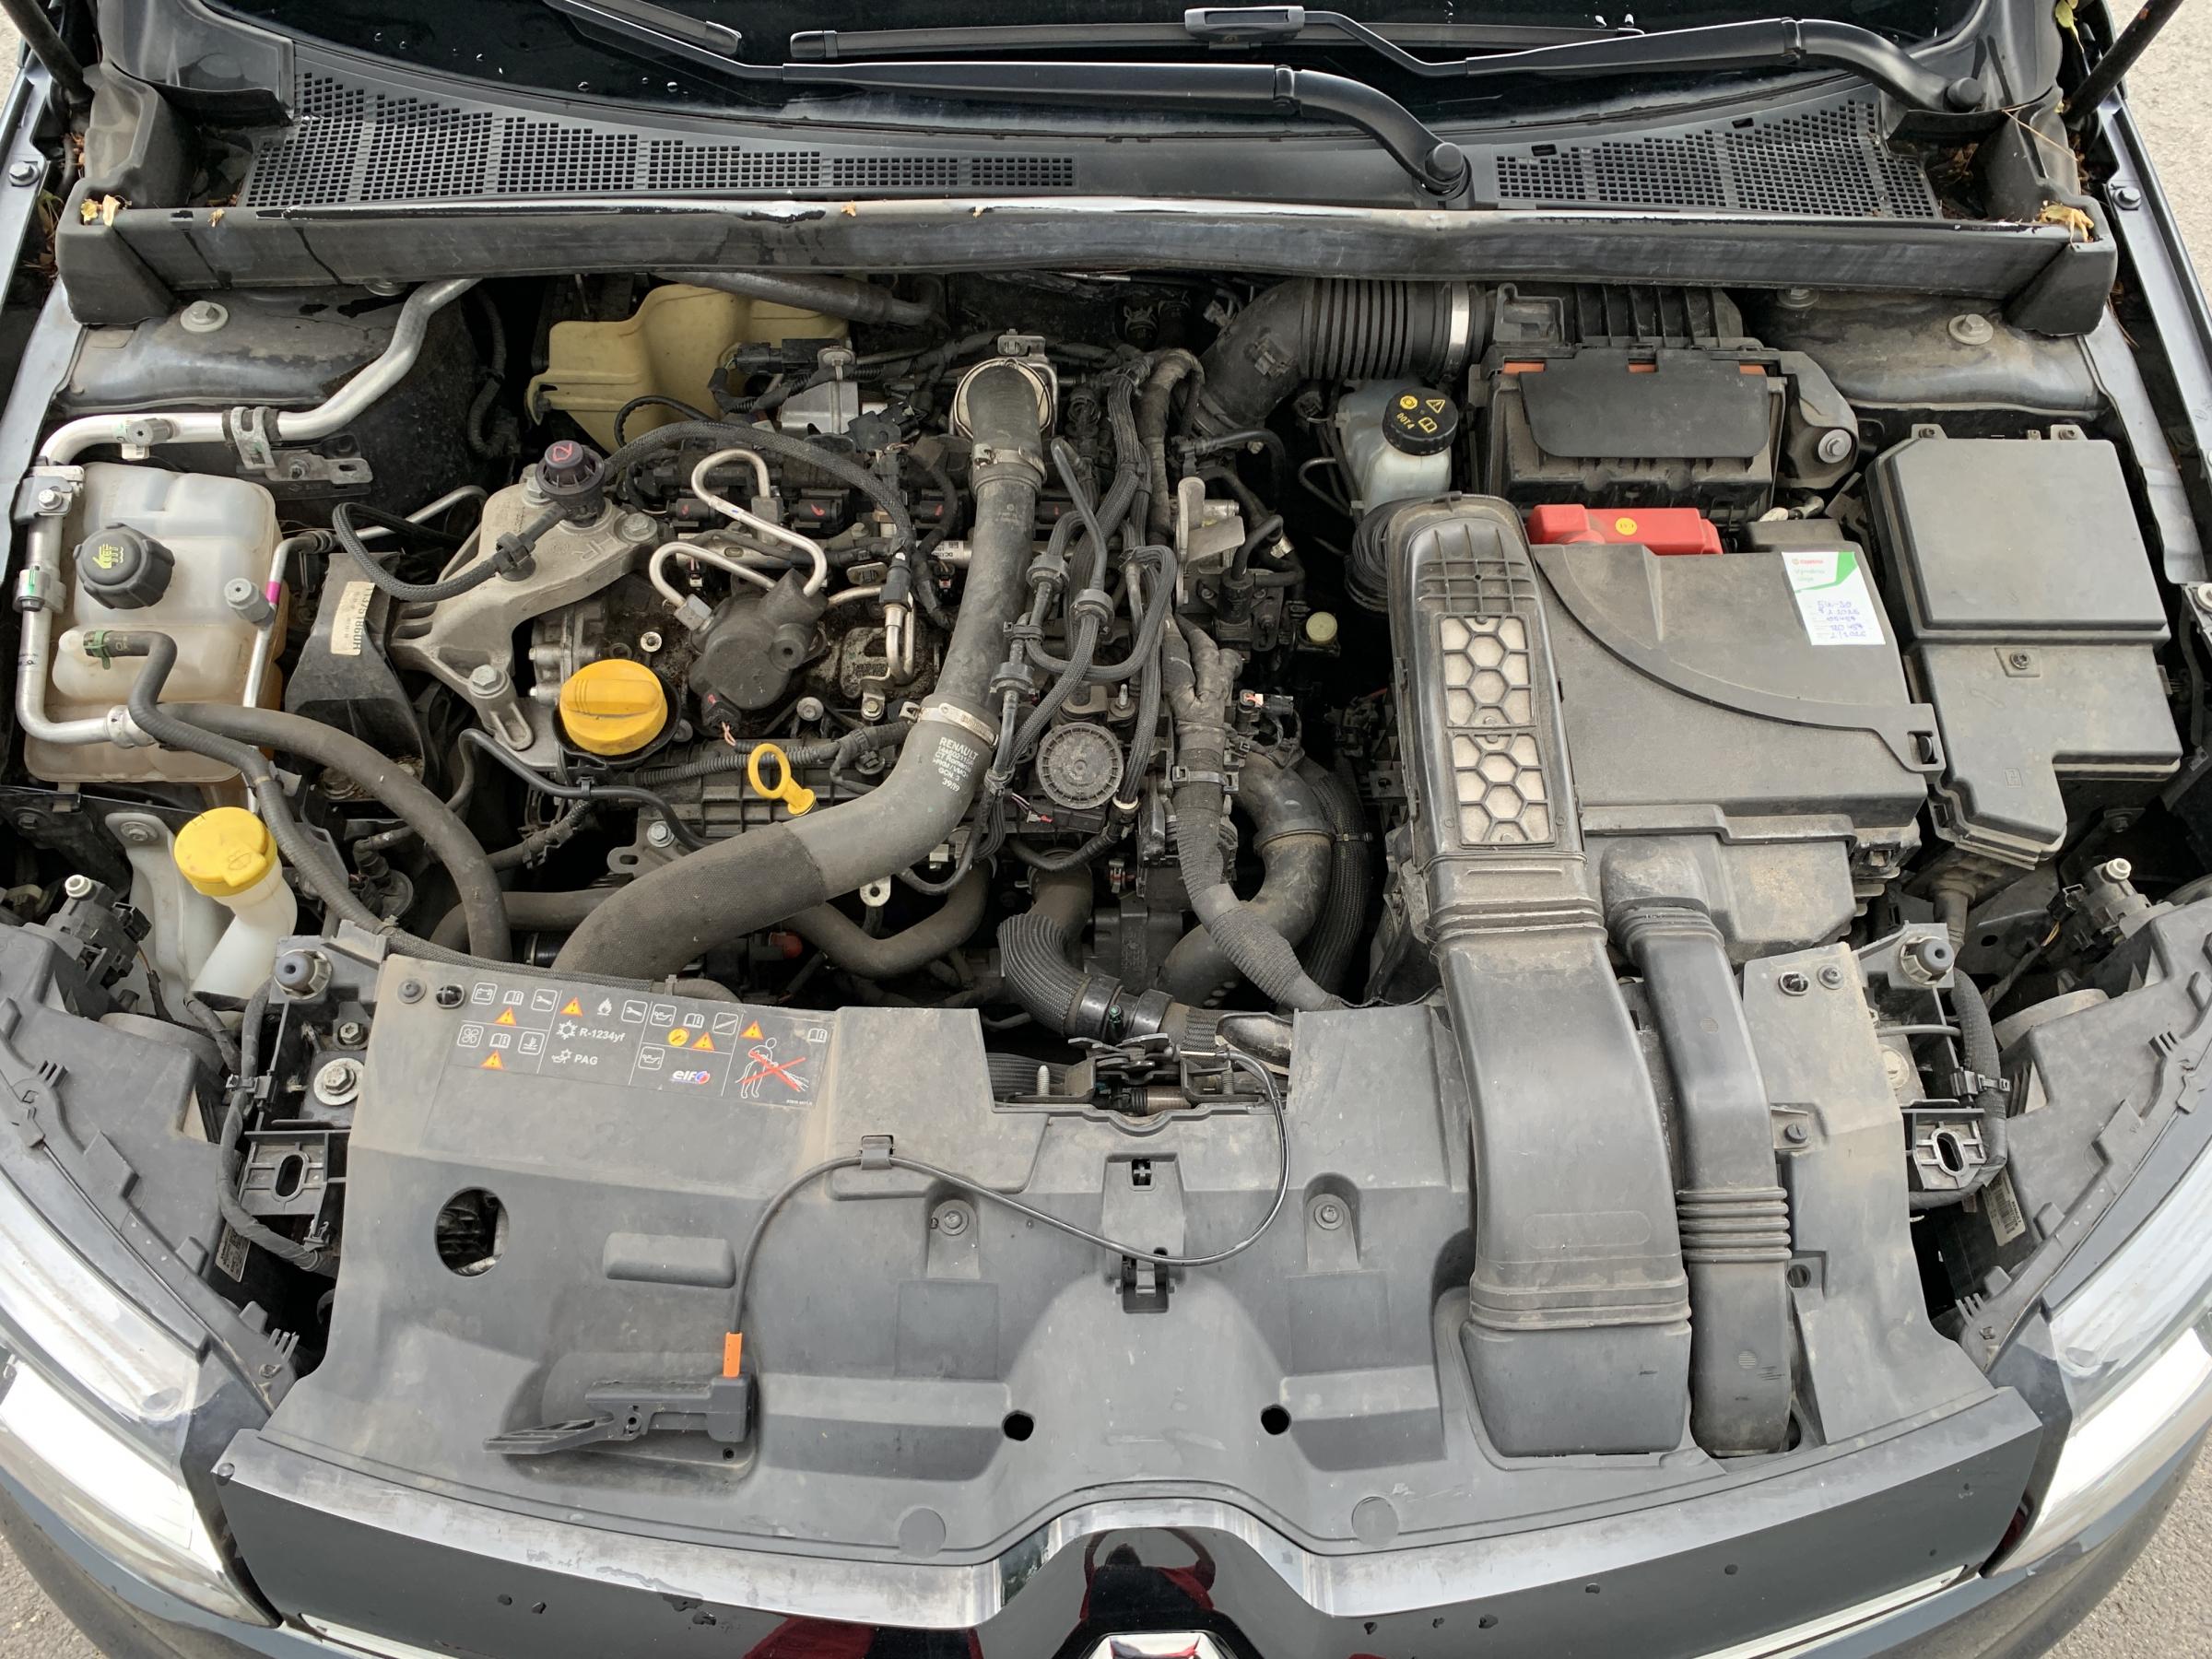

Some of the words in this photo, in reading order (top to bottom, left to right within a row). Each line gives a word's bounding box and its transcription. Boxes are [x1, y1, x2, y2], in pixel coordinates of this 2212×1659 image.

[939, 736, 979, 760] RENAULT
[579, 1027, 627, 1043] R-1234yf
[574, 1053, 599, 1065] PAG
[672, 1070, 698, 1082] elf
